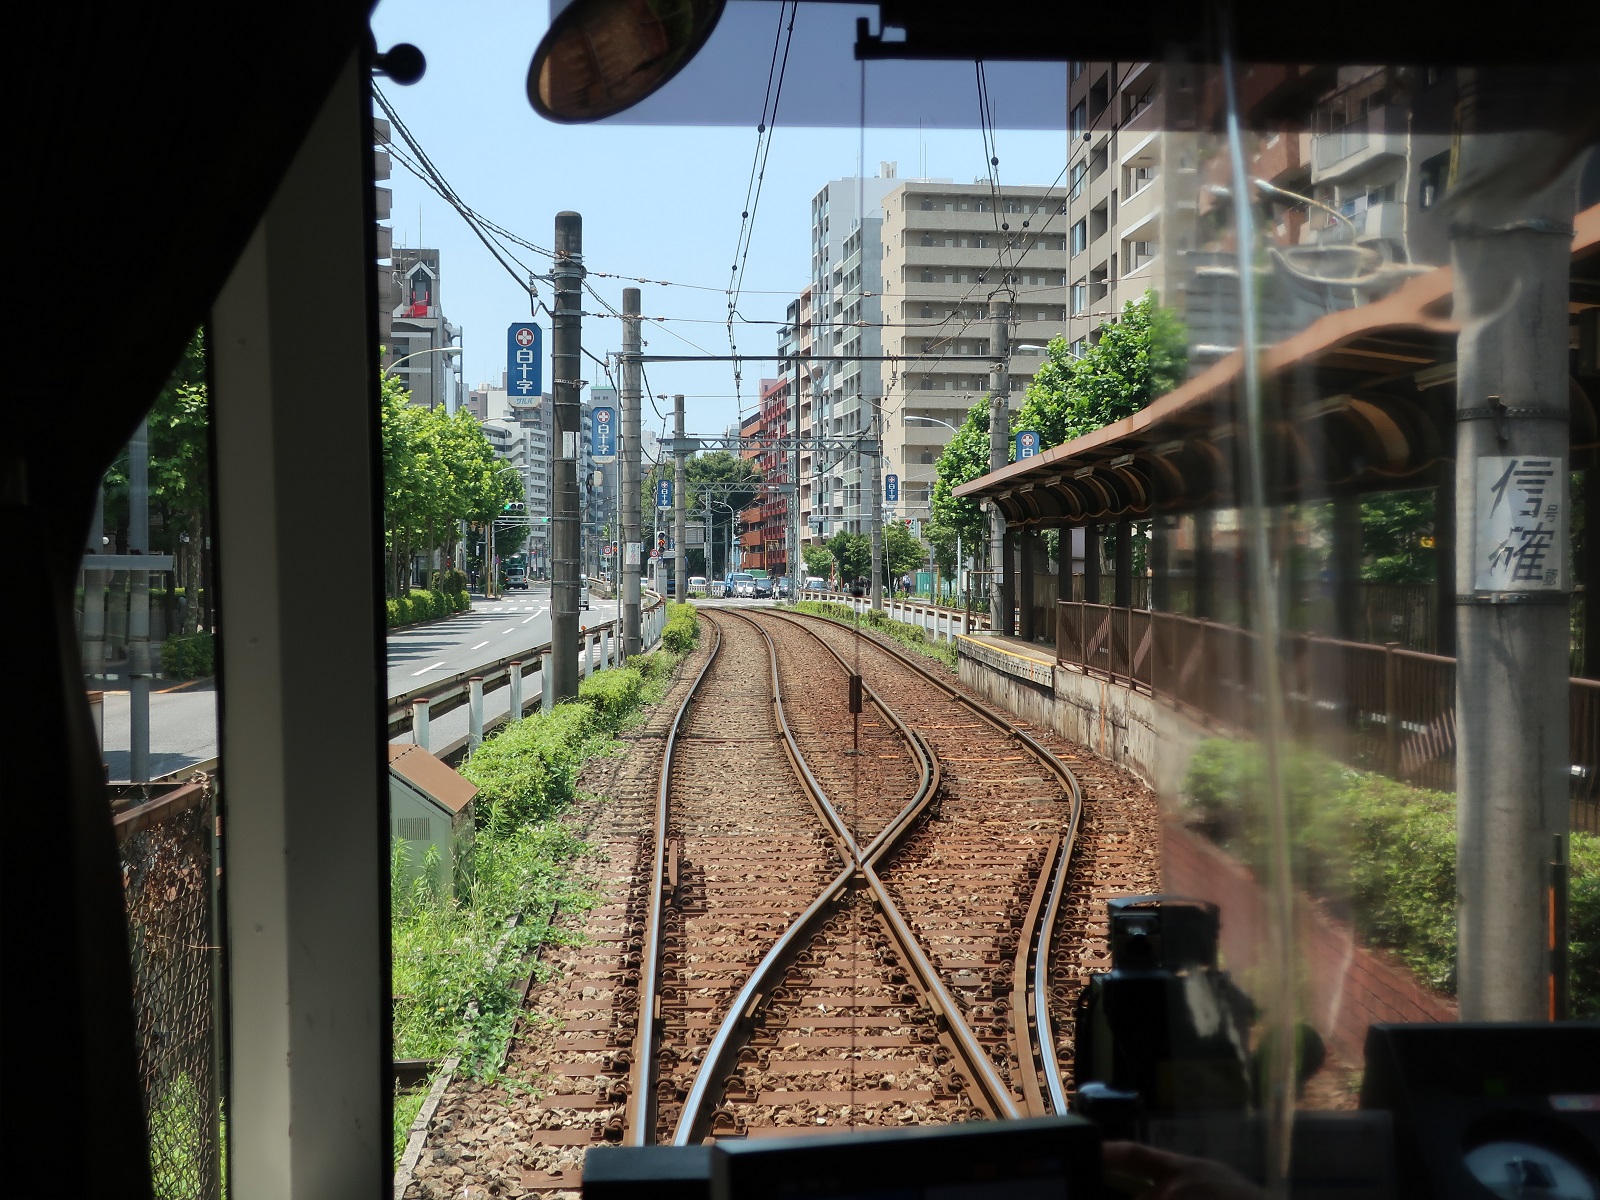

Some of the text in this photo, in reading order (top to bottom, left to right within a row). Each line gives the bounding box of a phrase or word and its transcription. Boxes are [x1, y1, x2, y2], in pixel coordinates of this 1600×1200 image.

[516, 348, 534, 395] 白十字
[597, 423, 610, 455] 白十字
[661, 488, 669, 506] 白十字
